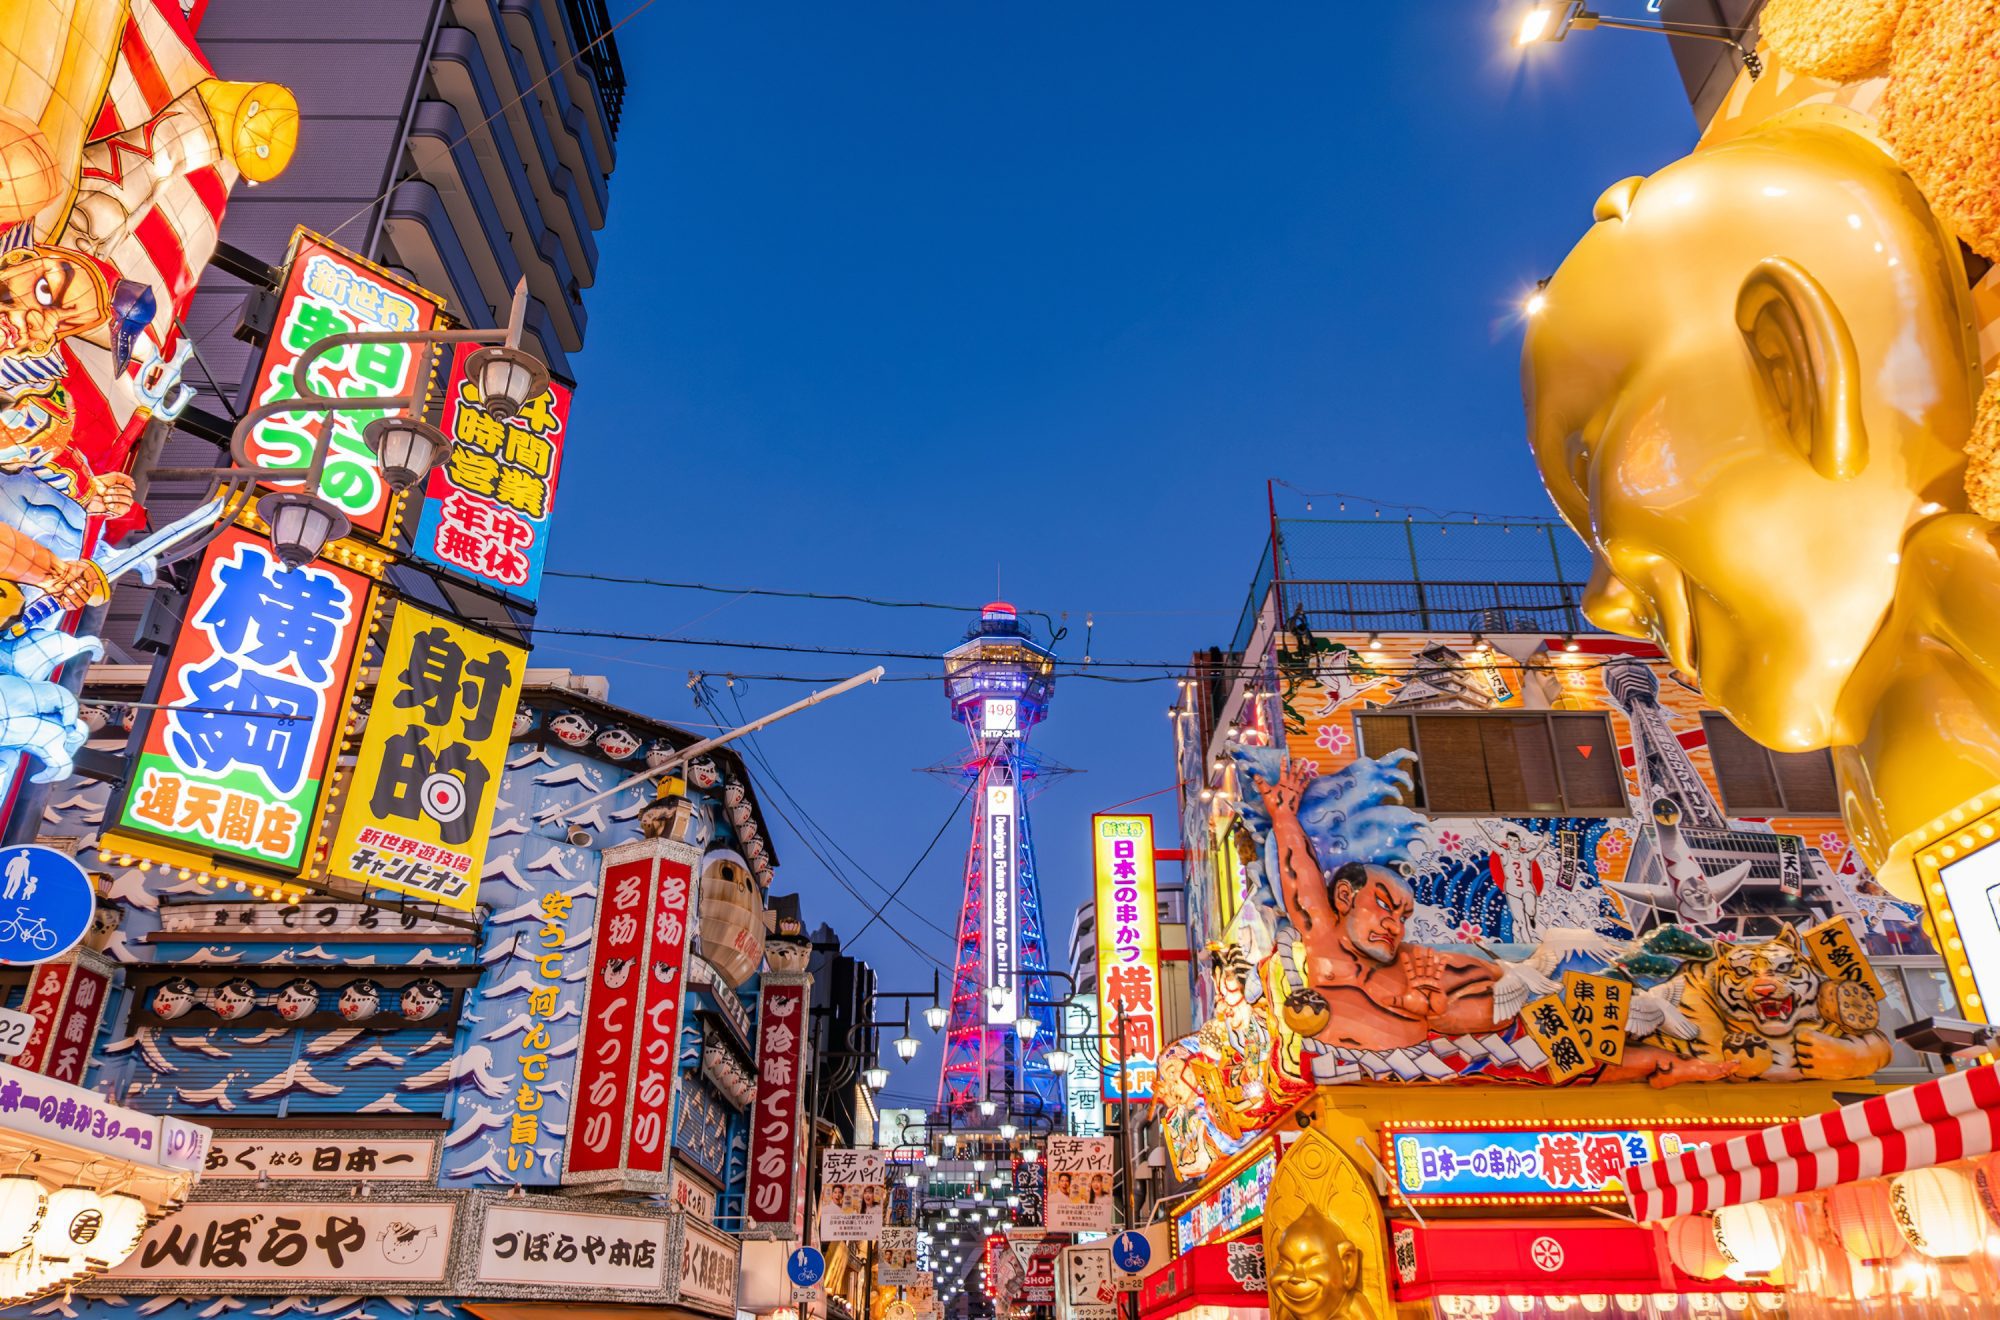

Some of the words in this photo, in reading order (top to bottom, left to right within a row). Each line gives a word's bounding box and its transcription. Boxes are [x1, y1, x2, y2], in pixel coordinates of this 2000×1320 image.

[309, 258, 413, 332] 新世界
[448, 444, 546, 518] 営業
[449, 498, 531, 548] 年中
[443, 526, 531, 580] 無休
[171, 548, 350, 792] 横綱
[980, 730, 1021, 739] HITACHI
[987, 704, 1014, 716] 498
[367, 626, 511, 845] 射的
[139, 775, 299, 855] 通天閣店
[993, 816, 1007, 859] Designing
[1101, 820, 1145, 839] 新世界
[350, 849, 469, 898] チャンピオン
[357, 827, 473, 873] 新世界遊技場
[995, 861, 1007, 889] Future
[1780, 838, 1801, 890] 通天閣
[608, 875, 641, 945] 名物
[656, 875, 688, 946] 名物
[993, 891, 1008, 926] Society
[1113, 839, 1140, 963] 日本一の串かつ
[995, 927, 1008, 942] for
[997, 943, 1009, 961] Our
[507, 890, 573, 1171] 安うて何んでも旨い
[1107, 965, 1155, 1060] 横綱
[1572, 979, 1595, 1048] 串かつ
[1599, 984, 1621, 1057] 日本一の
[1533, 1003, 1585, 1074] 横綱
[824, 1153, 858, 1168] 忘年
[1049, 1140, 1084, 1156] 忘年
[1421, 1147, 1537, 1178] 日本一の串かつ
[1539, 1135, 1625, 1185] 横綱
[793, 1291, 816, 1300] 9-22
[1024, 1276, 1053, 1285] SHOP
[1119, 1279, 1143, 1289] 9-22
